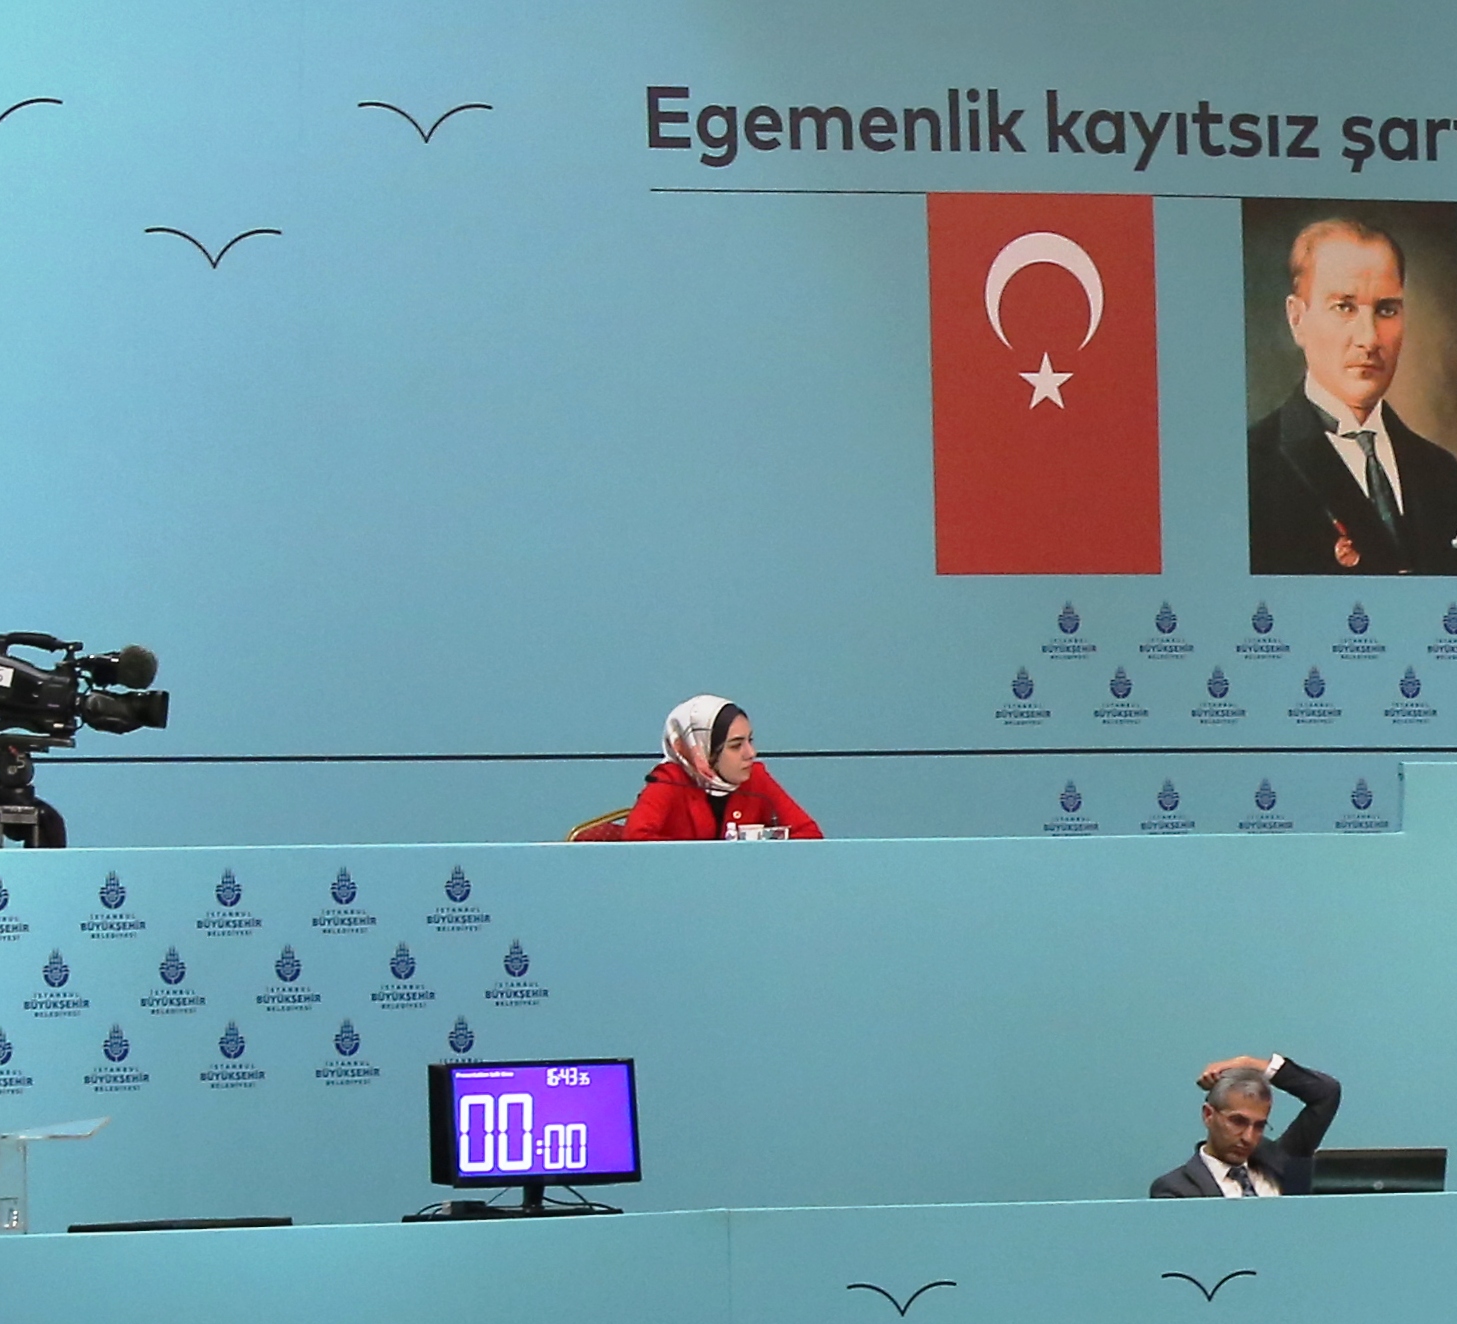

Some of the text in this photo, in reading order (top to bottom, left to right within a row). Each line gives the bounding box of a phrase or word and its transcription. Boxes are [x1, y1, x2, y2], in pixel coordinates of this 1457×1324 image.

[646, 85, 1027, 168] Egemenlik
[1045, 89, 1320, 172] kayıtsız
[459, 1092, 588, 1173] 00:00
